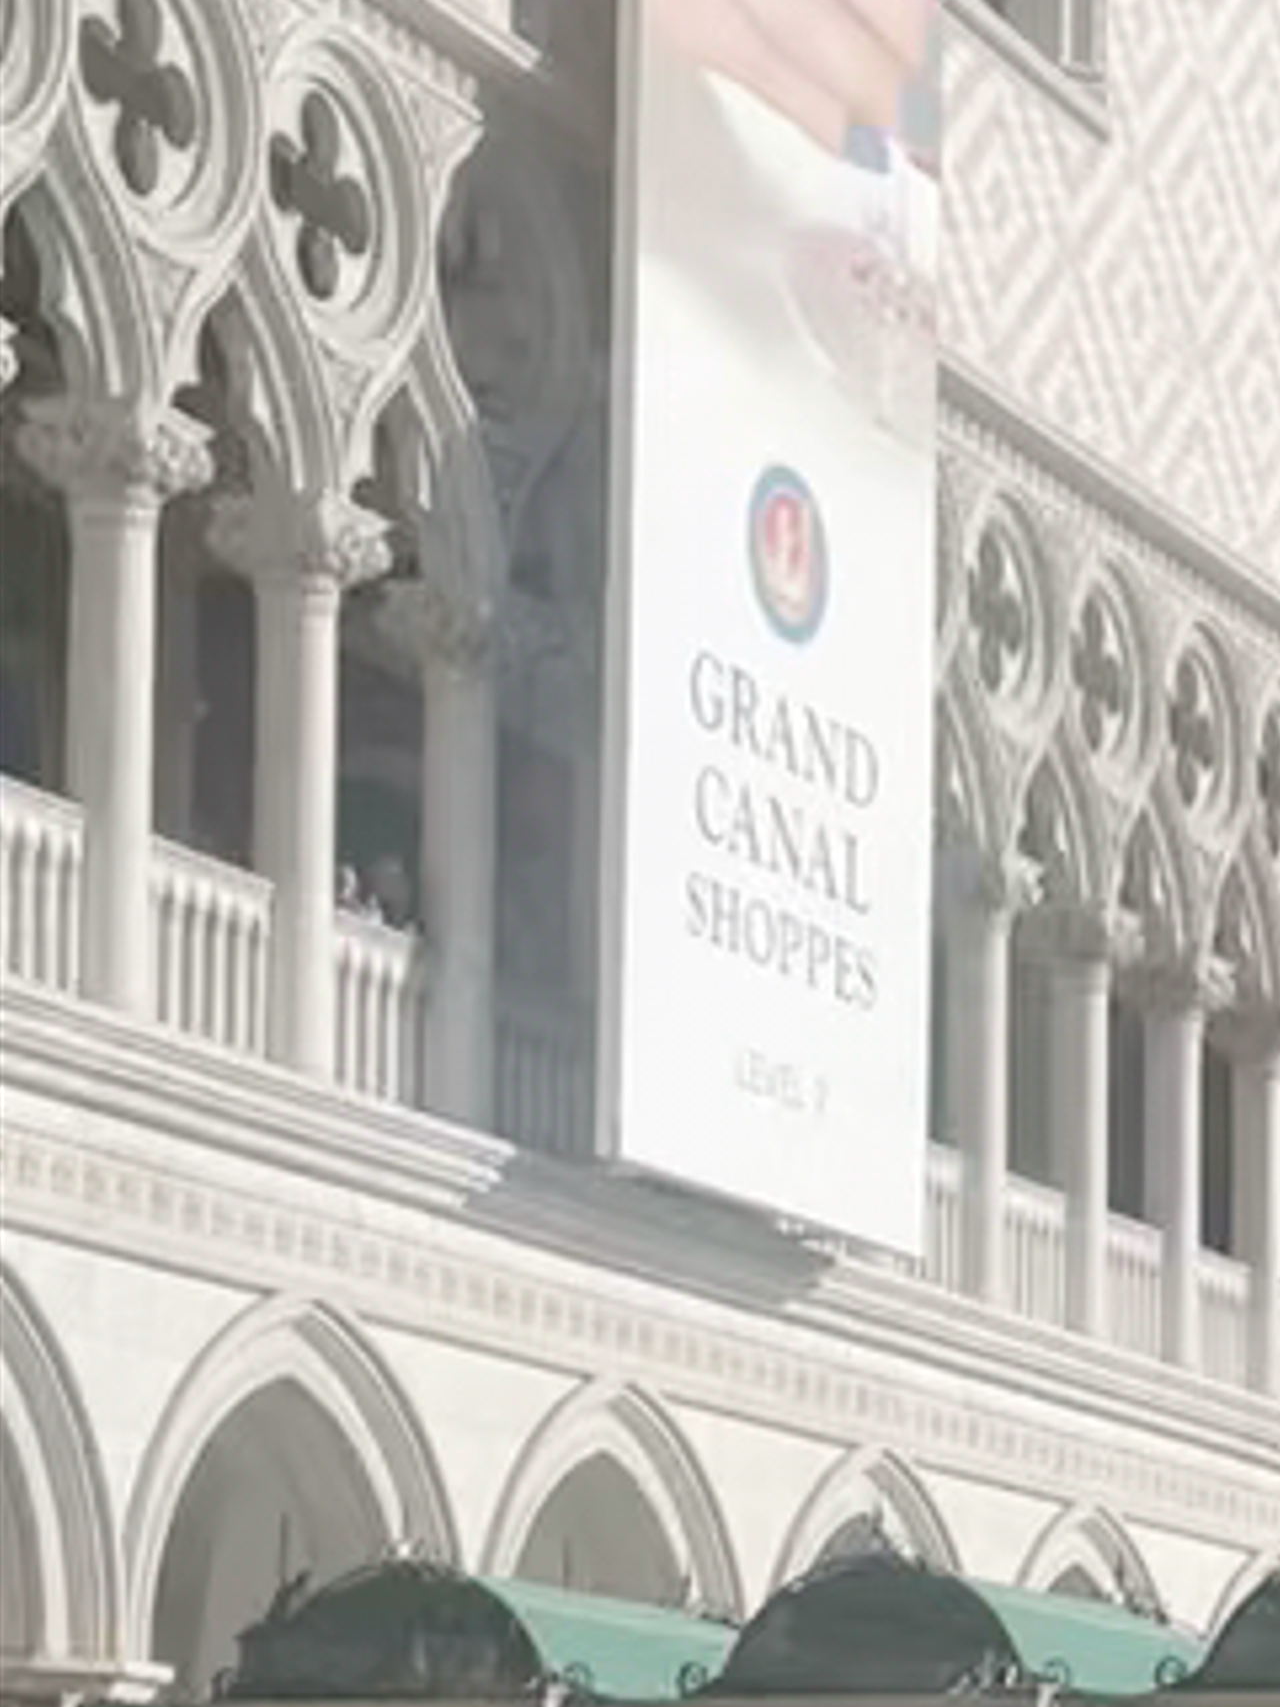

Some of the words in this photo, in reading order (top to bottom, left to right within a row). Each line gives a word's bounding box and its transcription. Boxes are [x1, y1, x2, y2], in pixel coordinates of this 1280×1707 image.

[689, 649, 880, 808] GRAND
[694, 764, 871, 916] CANAL
[684, 870, 878, 1013] SHOPPES
